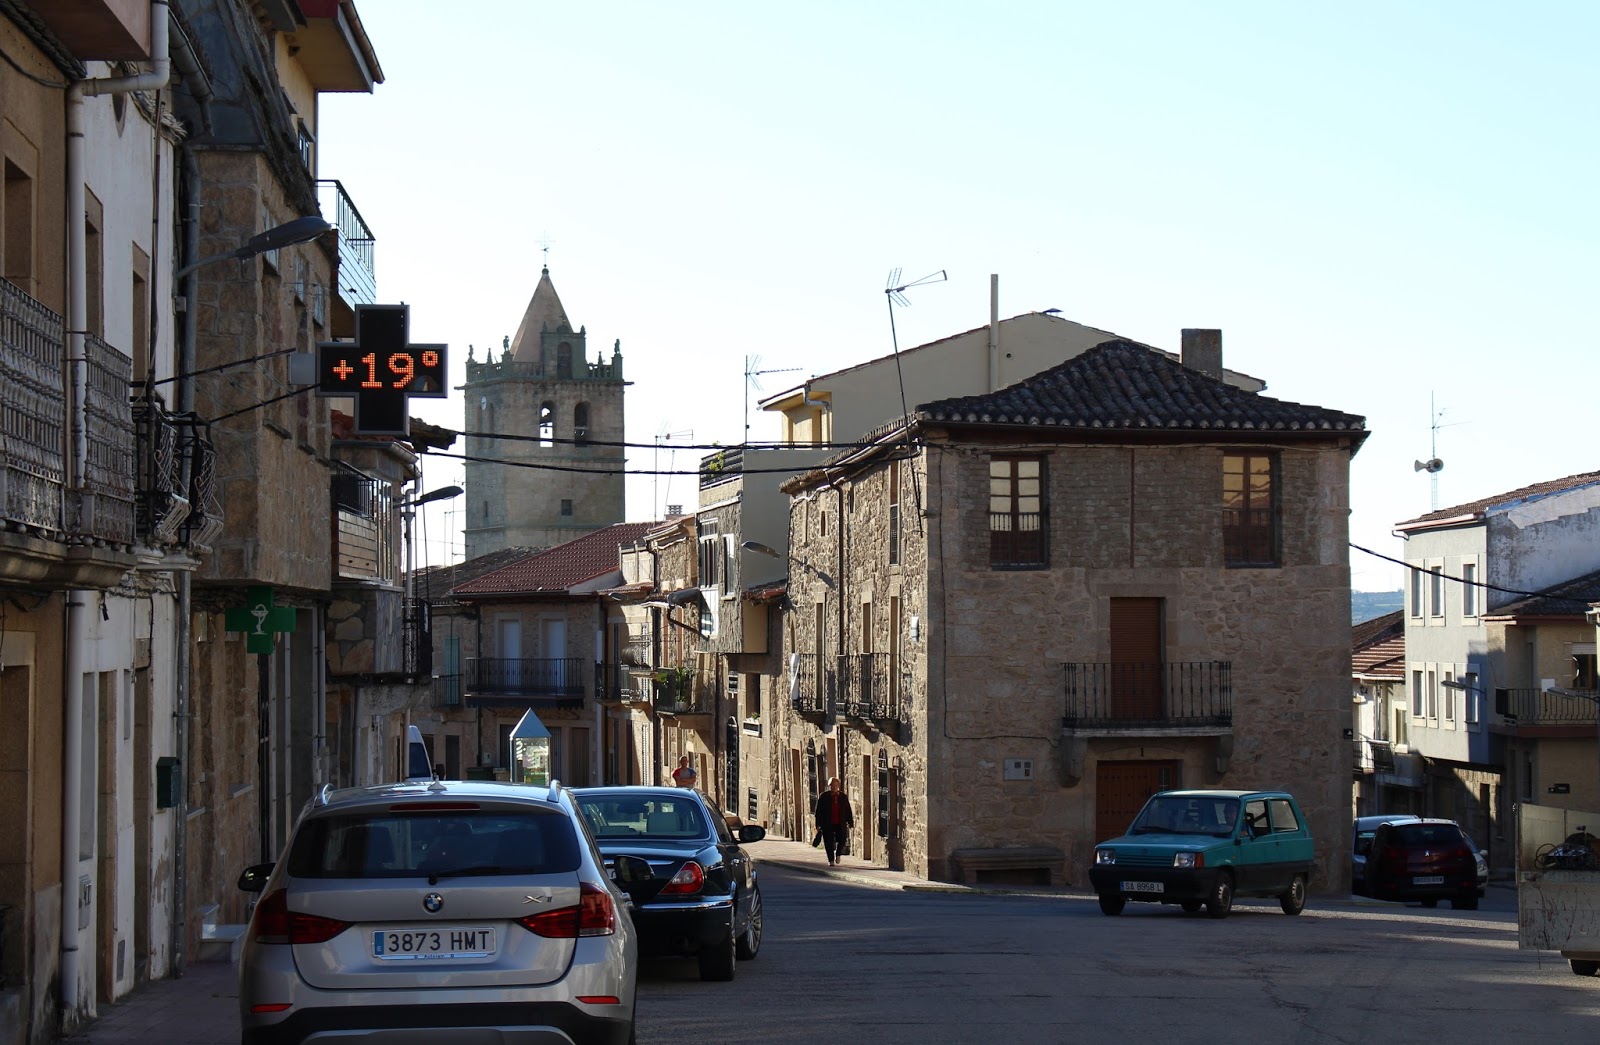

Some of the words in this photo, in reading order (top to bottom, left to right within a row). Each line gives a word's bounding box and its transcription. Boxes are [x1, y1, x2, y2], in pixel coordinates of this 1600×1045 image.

[1125, 882, 1135, 890] SA
[1136, 883, 1155, 891] 8958
[388, 932, 441, 953] 3873
[450, 931, 490, 950] HMT
